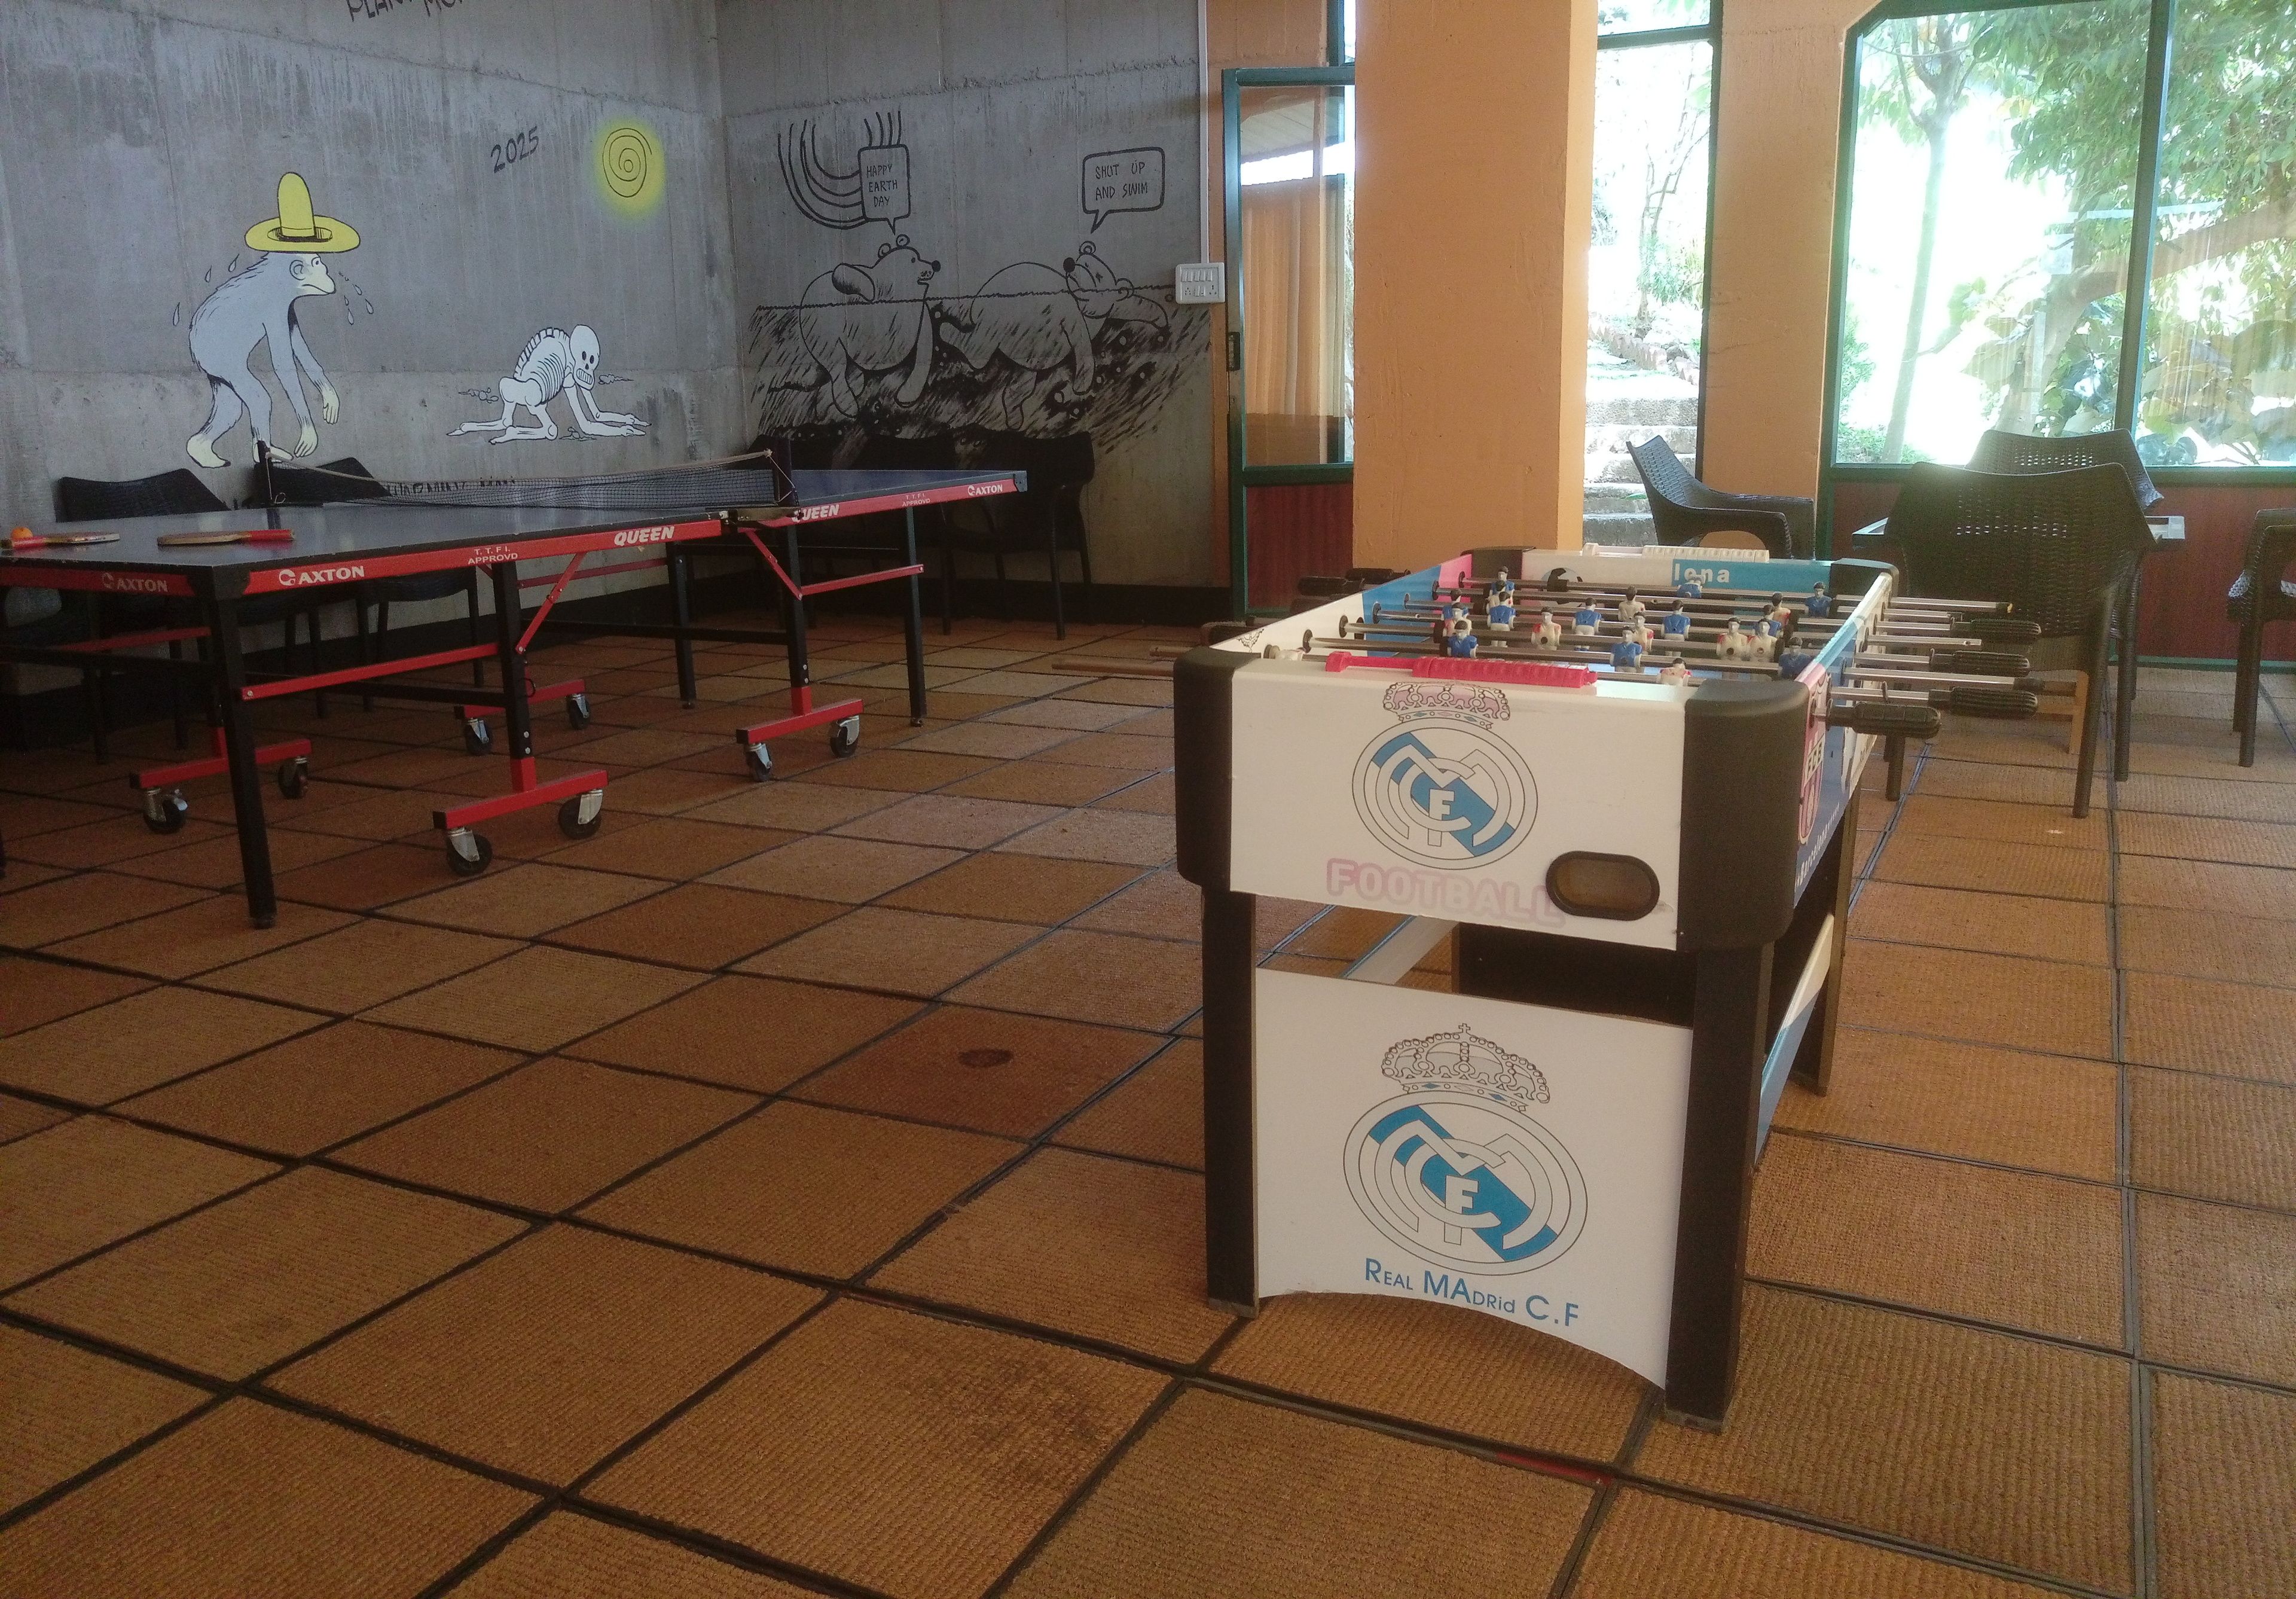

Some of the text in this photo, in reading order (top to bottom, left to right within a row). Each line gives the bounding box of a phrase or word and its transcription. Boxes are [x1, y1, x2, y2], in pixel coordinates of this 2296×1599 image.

[491, 126, 539, 173] 2025
[867, 163, 893, 178] HAPPY
[1095, 161, 1146, 179] SHUT UP
[869, 179, 898, 192] EARTH
[1095, 182, 1148, 201] AND SWIM
[874, 196, 890, 207] DAY
[902, 498, 931, 507] APPROVD
[614, 526, 675, 547] QUEEN
[468, 553, 518, 565] APPROVD
[1326, 857, 1566, 928] FOOTBALL
